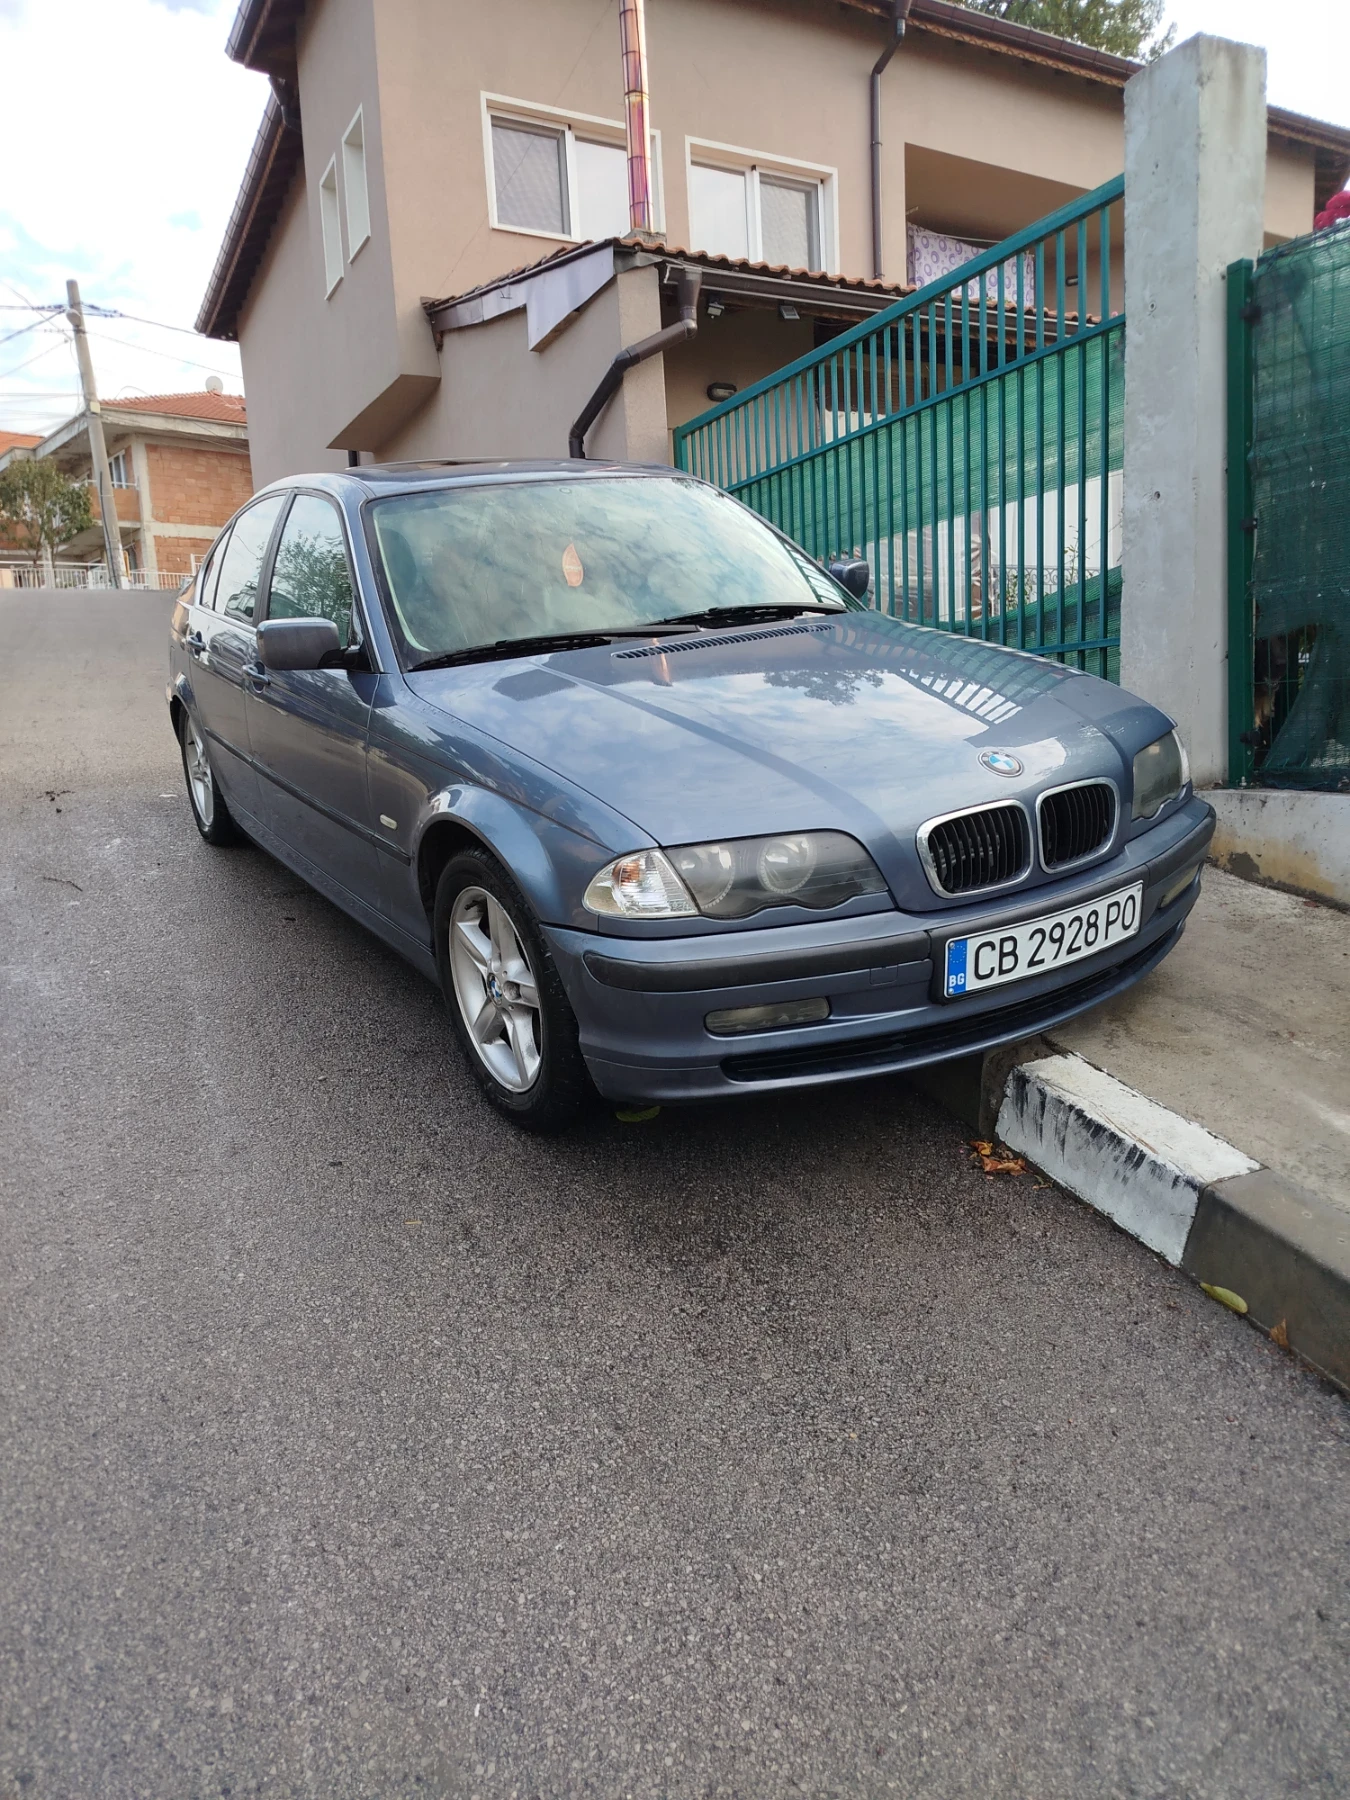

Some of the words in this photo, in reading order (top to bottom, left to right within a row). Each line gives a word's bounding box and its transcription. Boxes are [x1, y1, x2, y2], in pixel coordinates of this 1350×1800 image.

[974, 935, 1019, 981] CB
[1027, 909, 1099, 969] 2928
[1104, 894, 1136, 941] PO
[948, 972, 965, 988] BG
